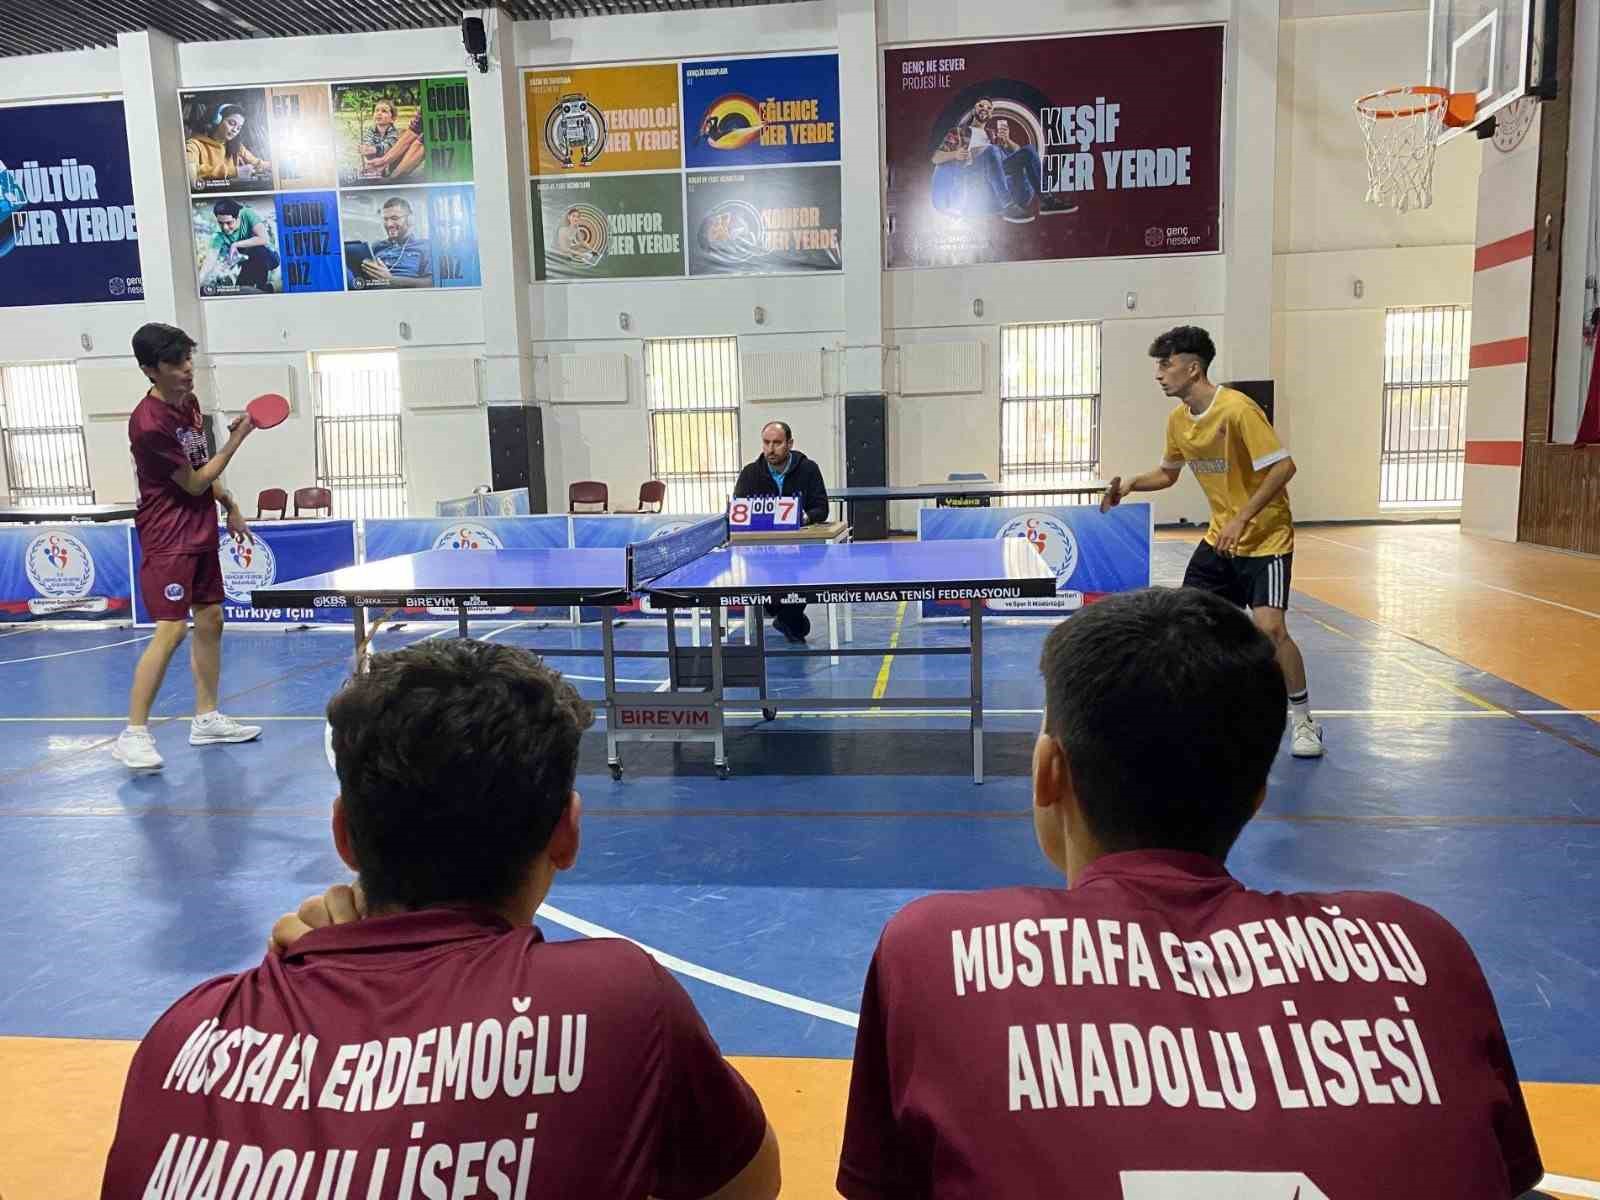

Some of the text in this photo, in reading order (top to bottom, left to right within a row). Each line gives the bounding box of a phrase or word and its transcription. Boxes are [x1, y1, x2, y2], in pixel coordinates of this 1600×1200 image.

[902, 57, 966, 75] GENÇ NE SEVER
[601, 101, 679, 130] TEKNOLOJİ
[758, 97, 819, 121] EĞLENCE
[760, 122, 835, 146] HER YERDE
[1040, 96, 1121, 151] KEŞİF
[604, 129, 679, 153] HER YERDE
[7, 158, 99, 205] KÜLTÜR
[1040, 146, 1192, 193] HER YERDE
[12, 205, 139, 246] HER YERDE
[607, 212, 663, 233] KONFOR
[1166, 226, 1189, 236] genç
[607, 233, 681, 256] HER YERDE
[793, 228, 838, 250] YERDE
[1166, 236, 1201, 246] nesever
[731, 503, 748, 523] 8
[778, 502, 795, 521] 7
[322, 596, 346, 605] KBS
[816, 587, 1021, 603] TÜRKİYE MASA TENİSİ FEDERASYONU
[951, 905, 1429, 999] MUSTAFA ERDEMOĞLU
[162, 996, 588, 1113] MUSTAFA ERDEMOĞLU
[1008, 995, 1443, 1112] ANADOLU LİSESİ
[366, 1112, 539, 1200] LİSESİ
